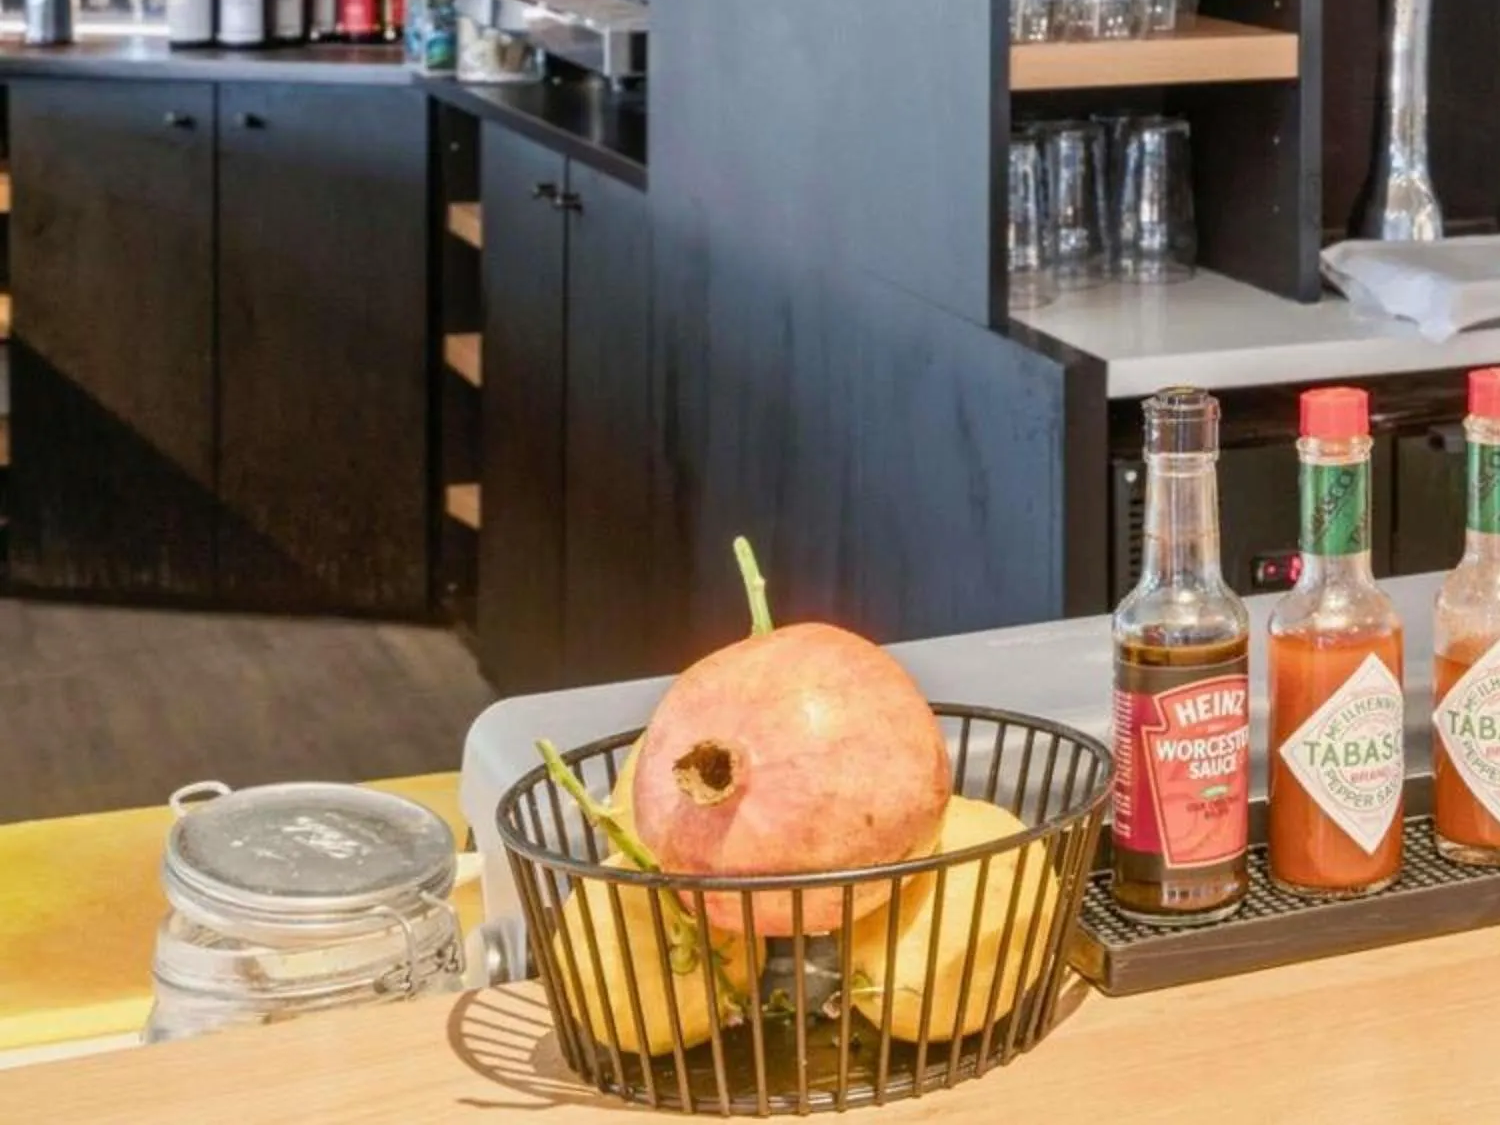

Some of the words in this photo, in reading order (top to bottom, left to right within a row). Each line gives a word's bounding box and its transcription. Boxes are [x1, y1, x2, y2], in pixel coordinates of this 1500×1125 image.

[1174, 689, 1246, 727] HEINZ
[1155, 725, 1249, 762] WORCESTE
[1303, 727, 1402, 768] TABASC
[1188, 753, 1237, 780] SAUCE
[1325, 766, 1374, 809] PEPPER
